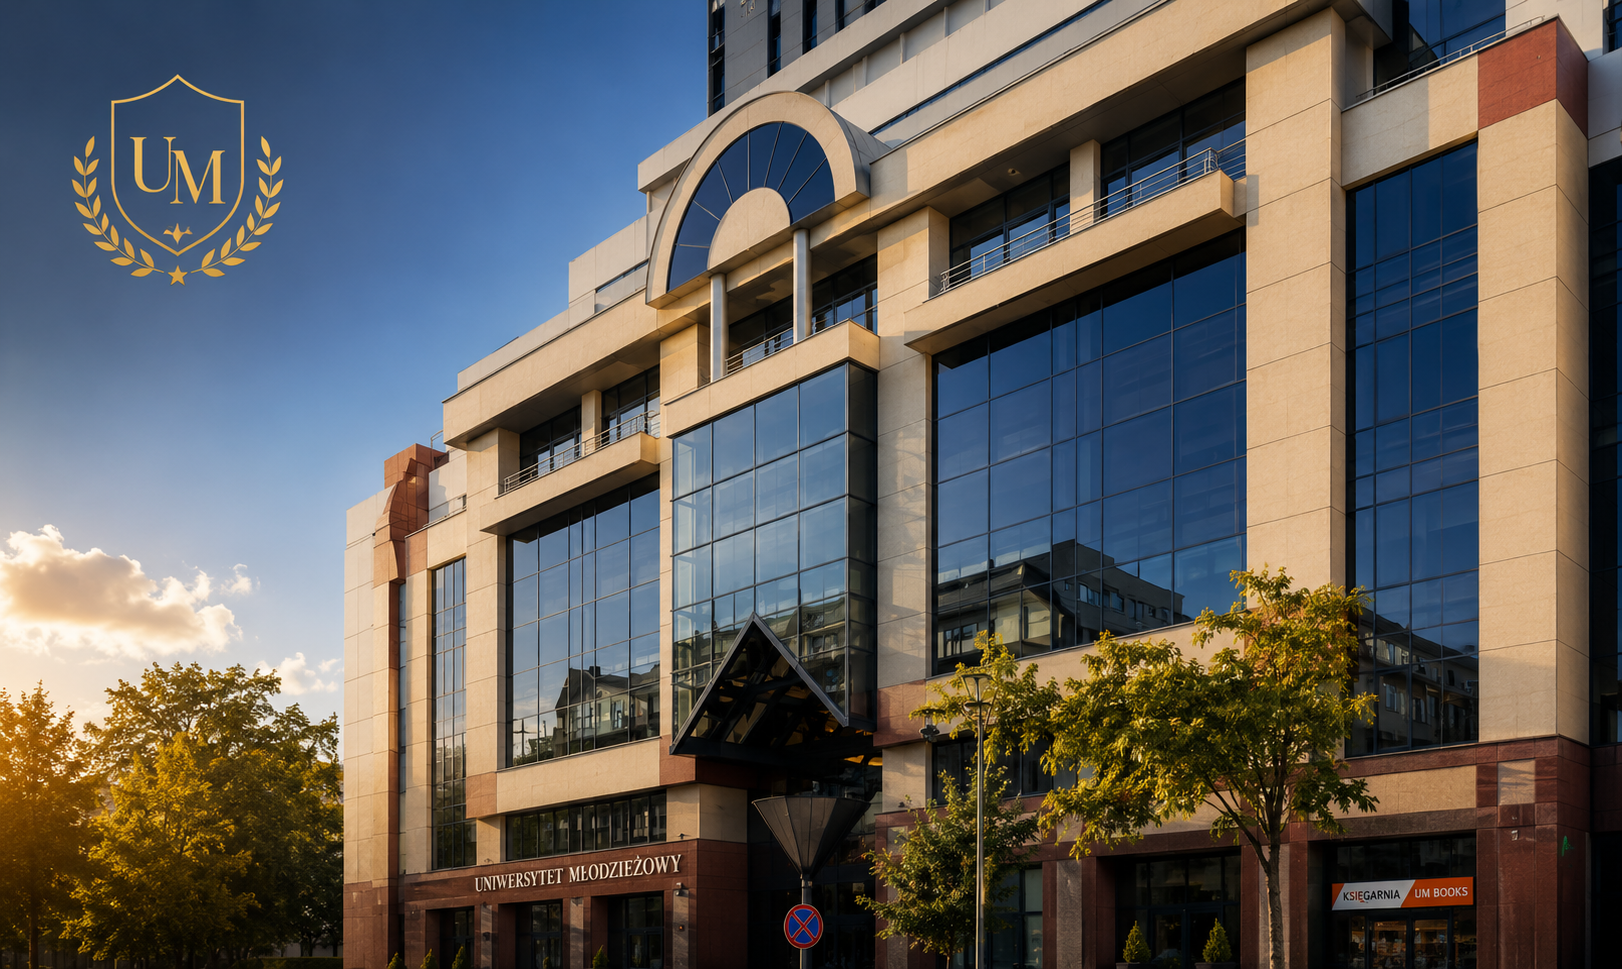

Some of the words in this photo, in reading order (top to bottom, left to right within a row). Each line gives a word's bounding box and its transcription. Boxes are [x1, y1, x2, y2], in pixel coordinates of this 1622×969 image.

[475, 868, 563, 892] UNIWERSYTET
[569, 854, 681, 883] MŁODZIEŻOWY
[1414, 888, 1430, 899] UM
[1433, 886, 1468, 898] BOOKS
